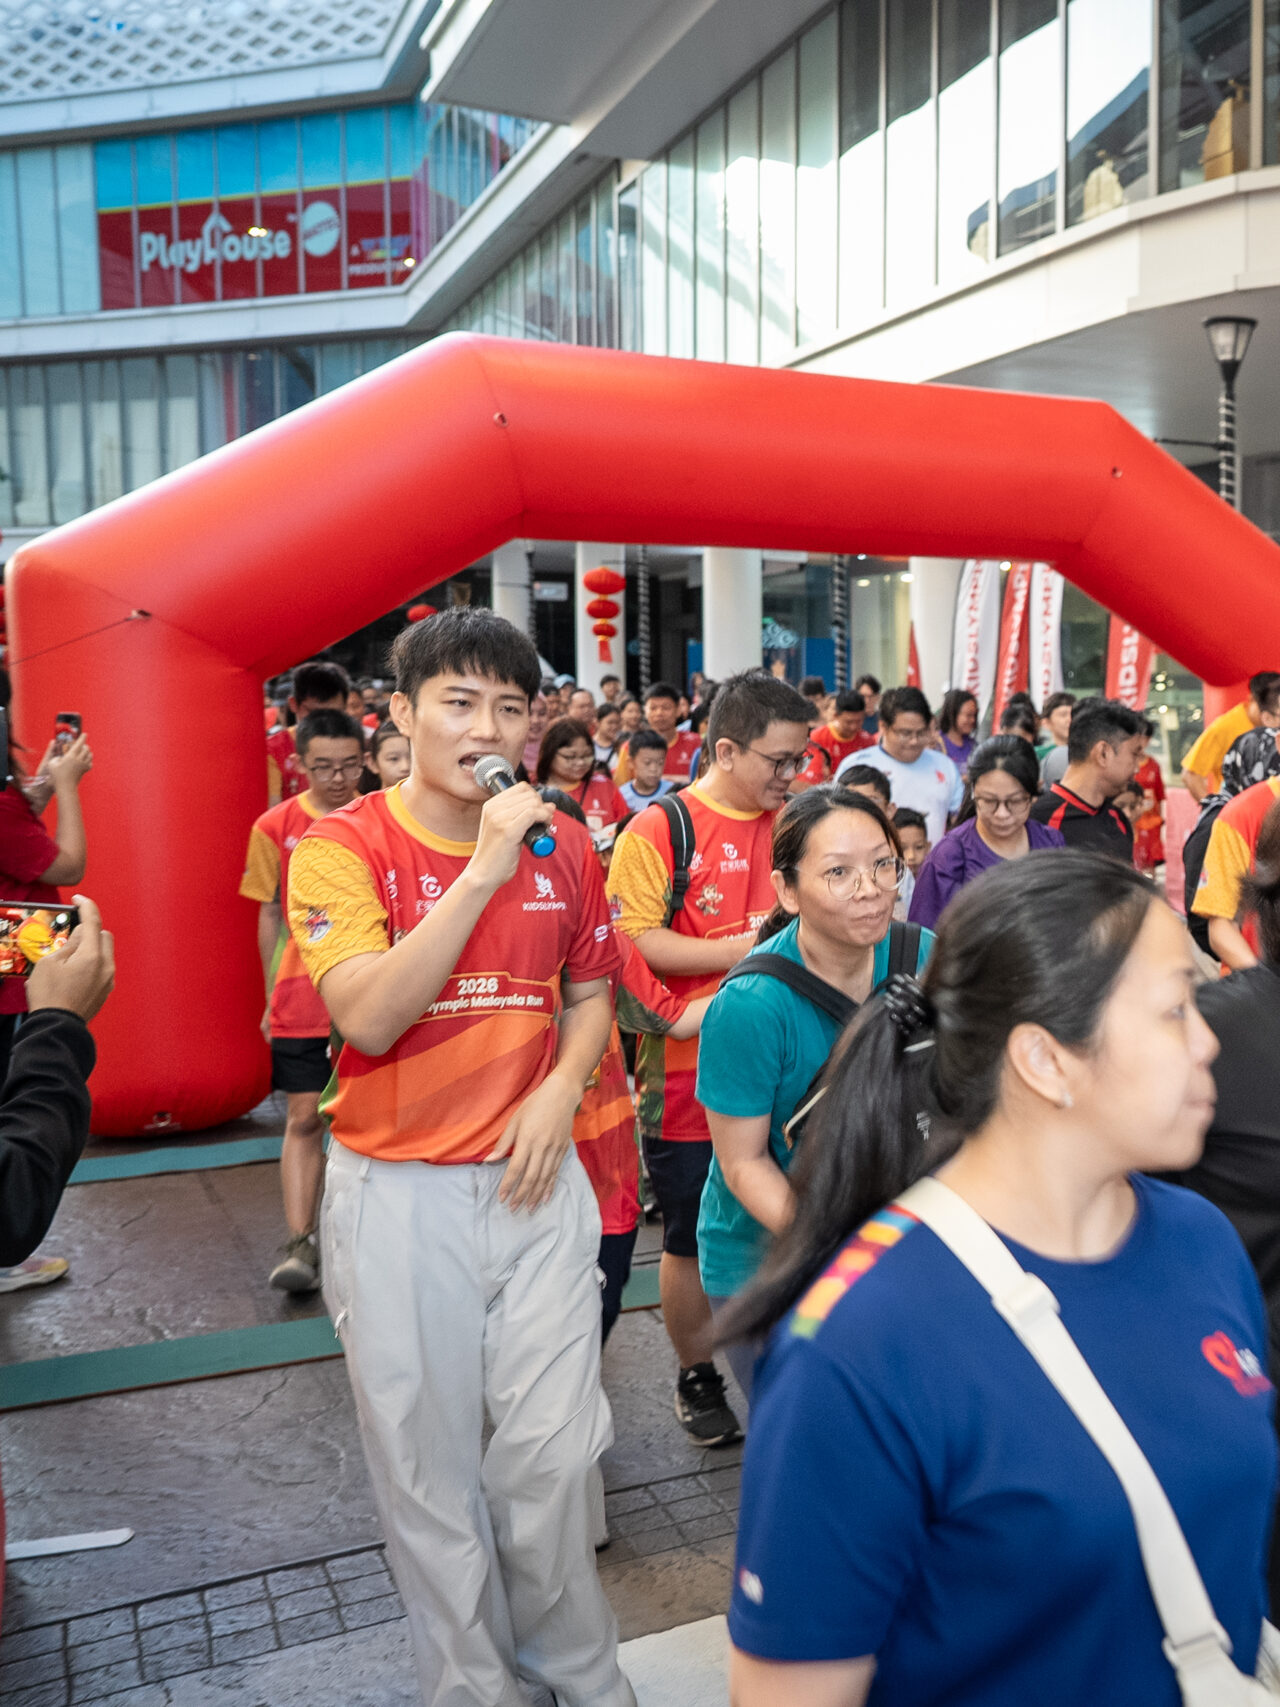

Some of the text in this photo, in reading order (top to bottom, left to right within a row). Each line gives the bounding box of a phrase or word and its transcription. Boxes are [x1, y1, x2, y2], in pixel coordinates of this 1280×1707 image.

[457, 976, 499, 996] 2026
[470, 993, 526, 1009] Malaysia
[526, 994, 544, 1007] Run
